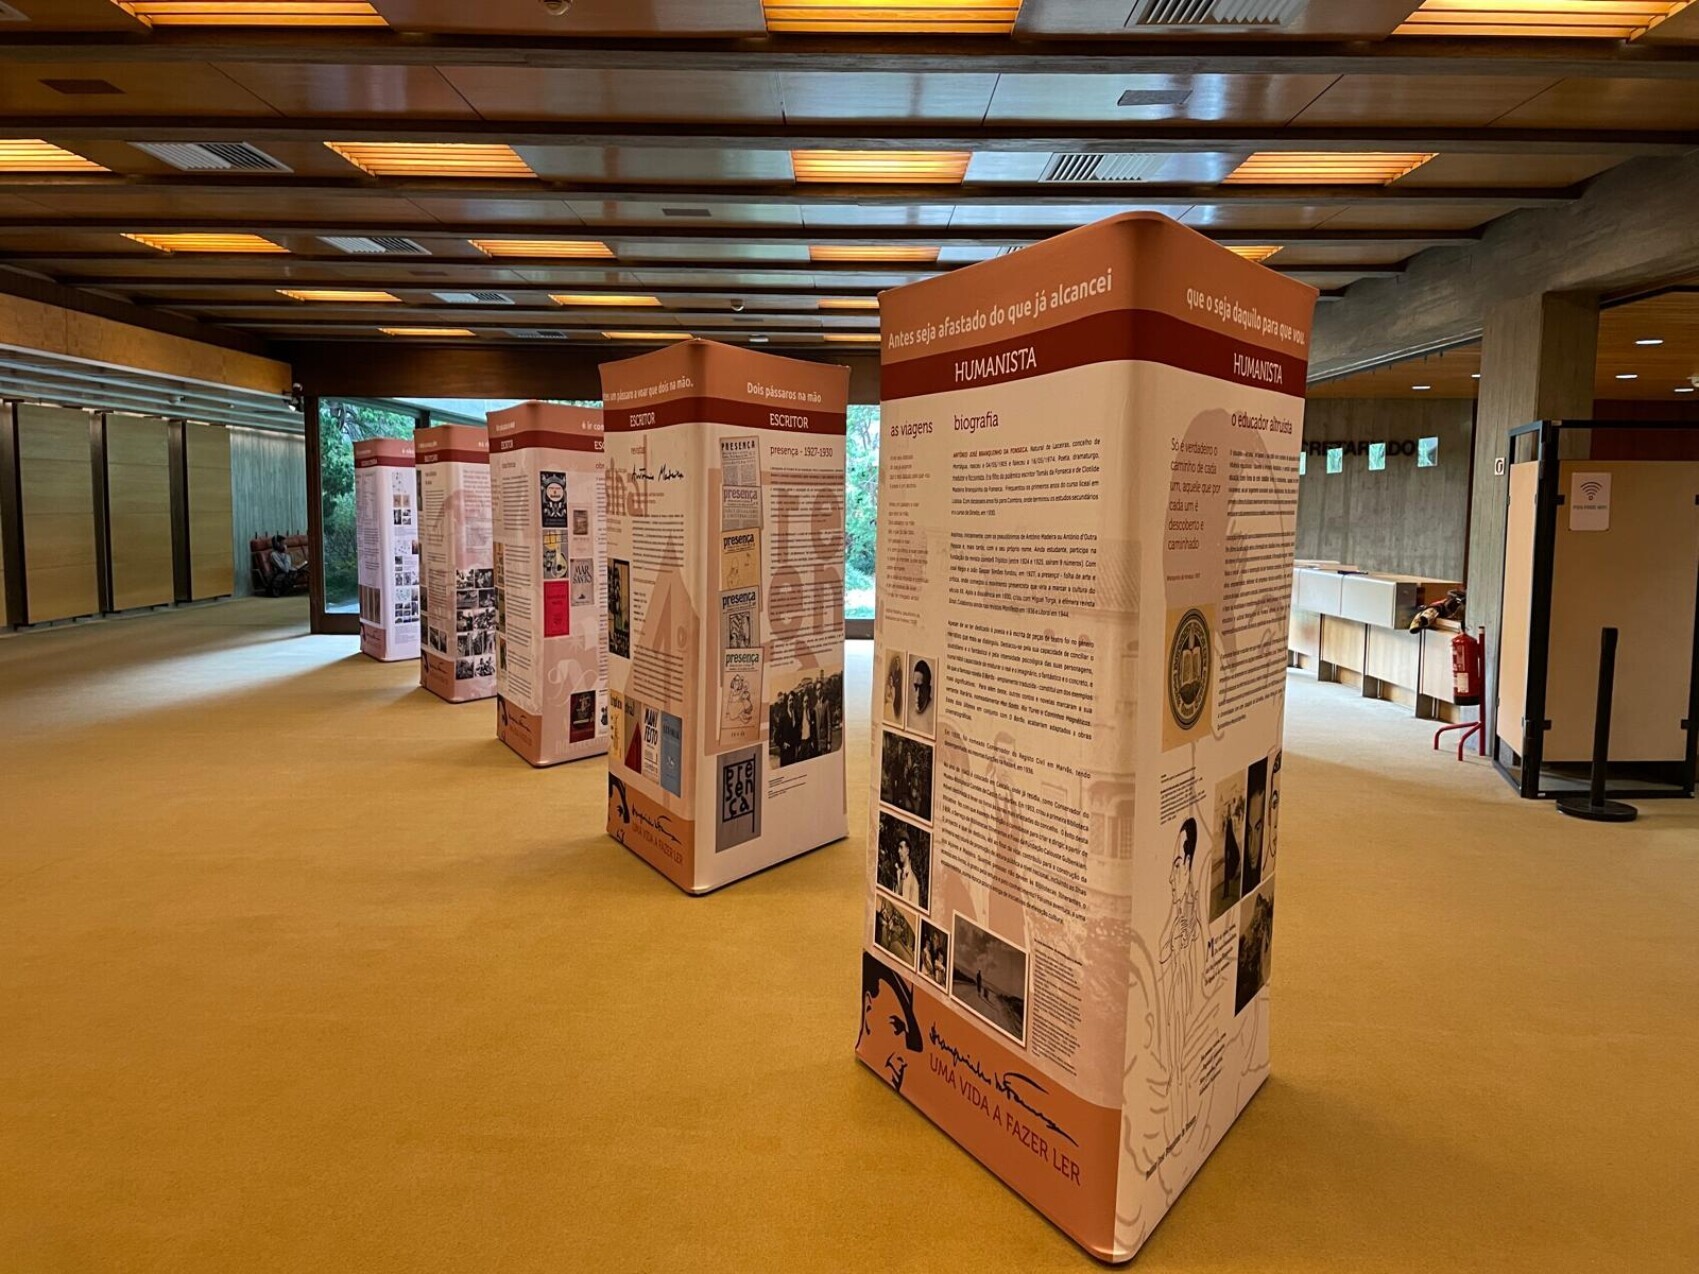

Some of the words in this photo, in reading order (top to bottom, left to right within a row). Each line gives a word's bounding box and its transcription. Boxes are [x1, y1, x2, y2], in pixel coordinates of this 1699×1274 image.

[888, 331, 914, 350] Antes
[916, 322, 936, 344] seja
[939, 310, 986, 338] afastado
[989, 305, 1005, 327] do
[1008, 299, 1031, 325] que
[1033, 290, 1046, 318] já
[1050, 267, 1112, 308] alcancei
[1187, 288, 1204, 309] que
[1206, 298, 1212, 311] o
[1214, 296, 1231, 321] seja
[1233, 301, 1261, 330] daquilo
[1262, 318, 1278, 336] para
[1279, 323, 1292, 341] que
[954, 347, 1037, 382] HUMANISTA
[1234, 353, 1282, 384] HUMANISTA
[747, 382, 764, 395] Dois
[765, 386, 796, 400] pássaros
[798, 392, 806, 401] na
[807, 391, 821, 403] mão
[630, 411, 656, 427] ESCRITOR
[770, 413, 808, 429] ESCRITOR
[953, 411, 999, 434] biografia
[1231, 414, 1236, 426] o
[1238, 412, 1269, 430] educador
[891, 425, 899, 437] as
[900, 421, 933, 439] viagens
[770, 447, 798, 457] presença
[804, 447, 833, 457] 1927-1930
[724, 489, 757, 502] presença
[724, 533, 754, 550] presença
[722, 591, 755, 609] presença
[725, 653, 759, 667] presença
[930, 1053, 957, 1089] UMA
[959, 1076, 989, 1117] VIDA
[993, 1109, 1002, 1126] A
[1006, 1113, 1049, 1162] FAZER
[1053, 1148, 1080, 1186] LER
